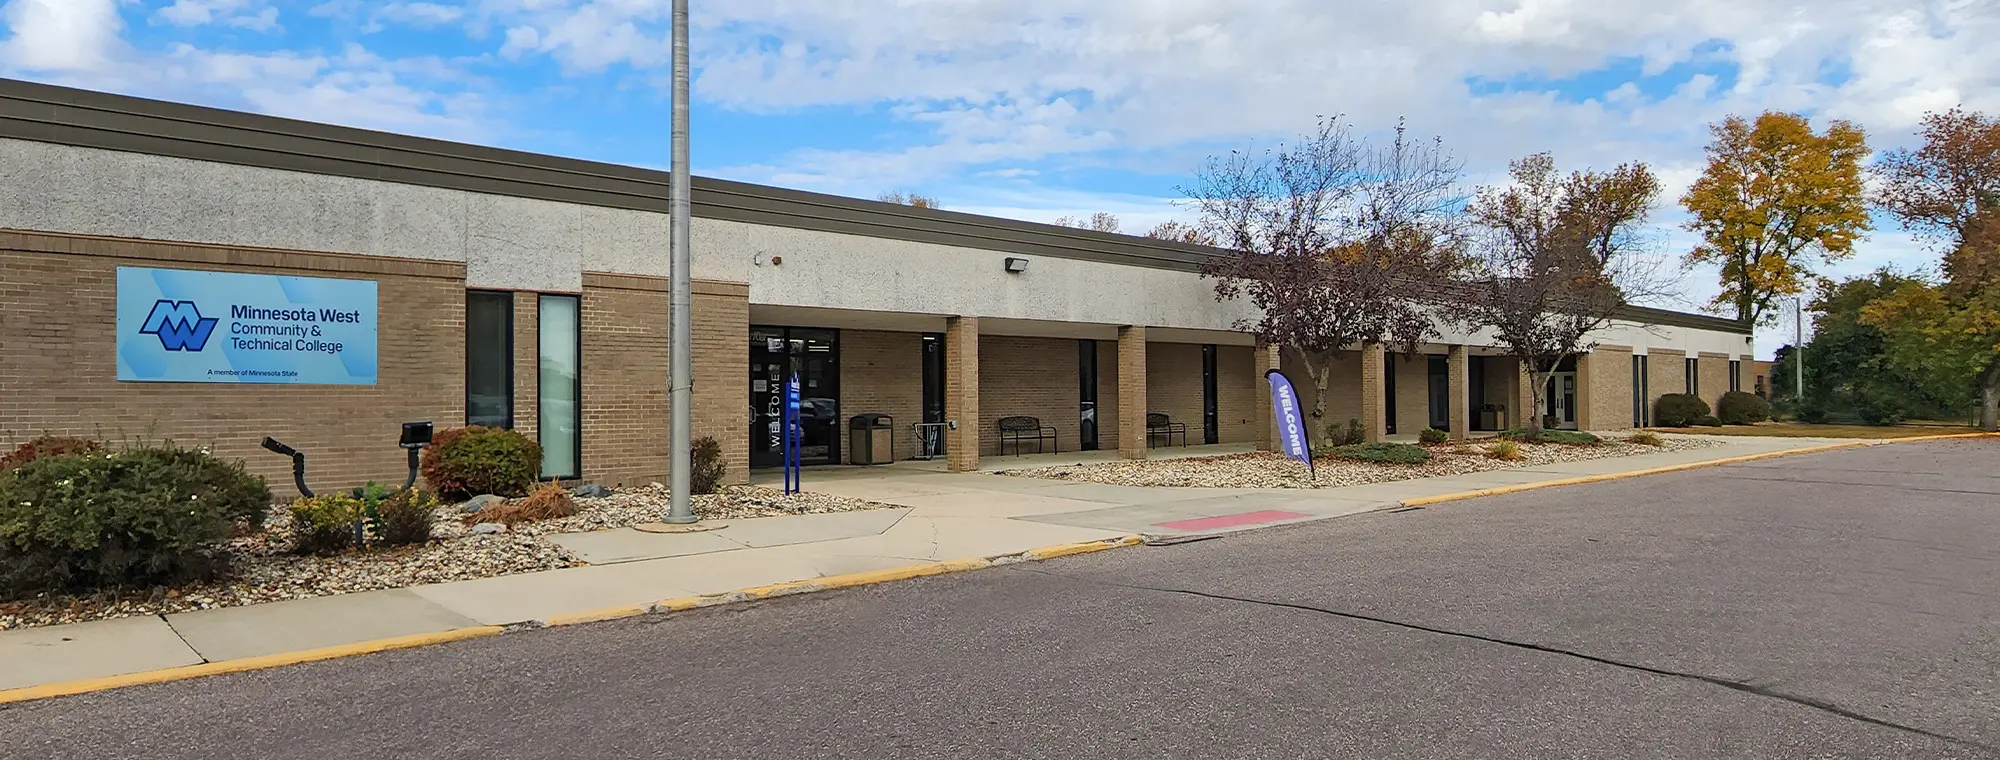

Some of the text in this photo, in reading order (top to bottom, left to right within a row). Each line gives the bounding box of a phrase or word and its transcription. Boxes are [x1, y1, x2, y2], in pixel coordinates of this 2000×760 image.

[231, 304, 360, 323] Minnesota West
[231, 321, 322, 339] Community &
[231, 337, 343, 354] Technical College
[771, 373, 780, 448] WELCOME
[1278, 384, 1303, 456] WELCOME
